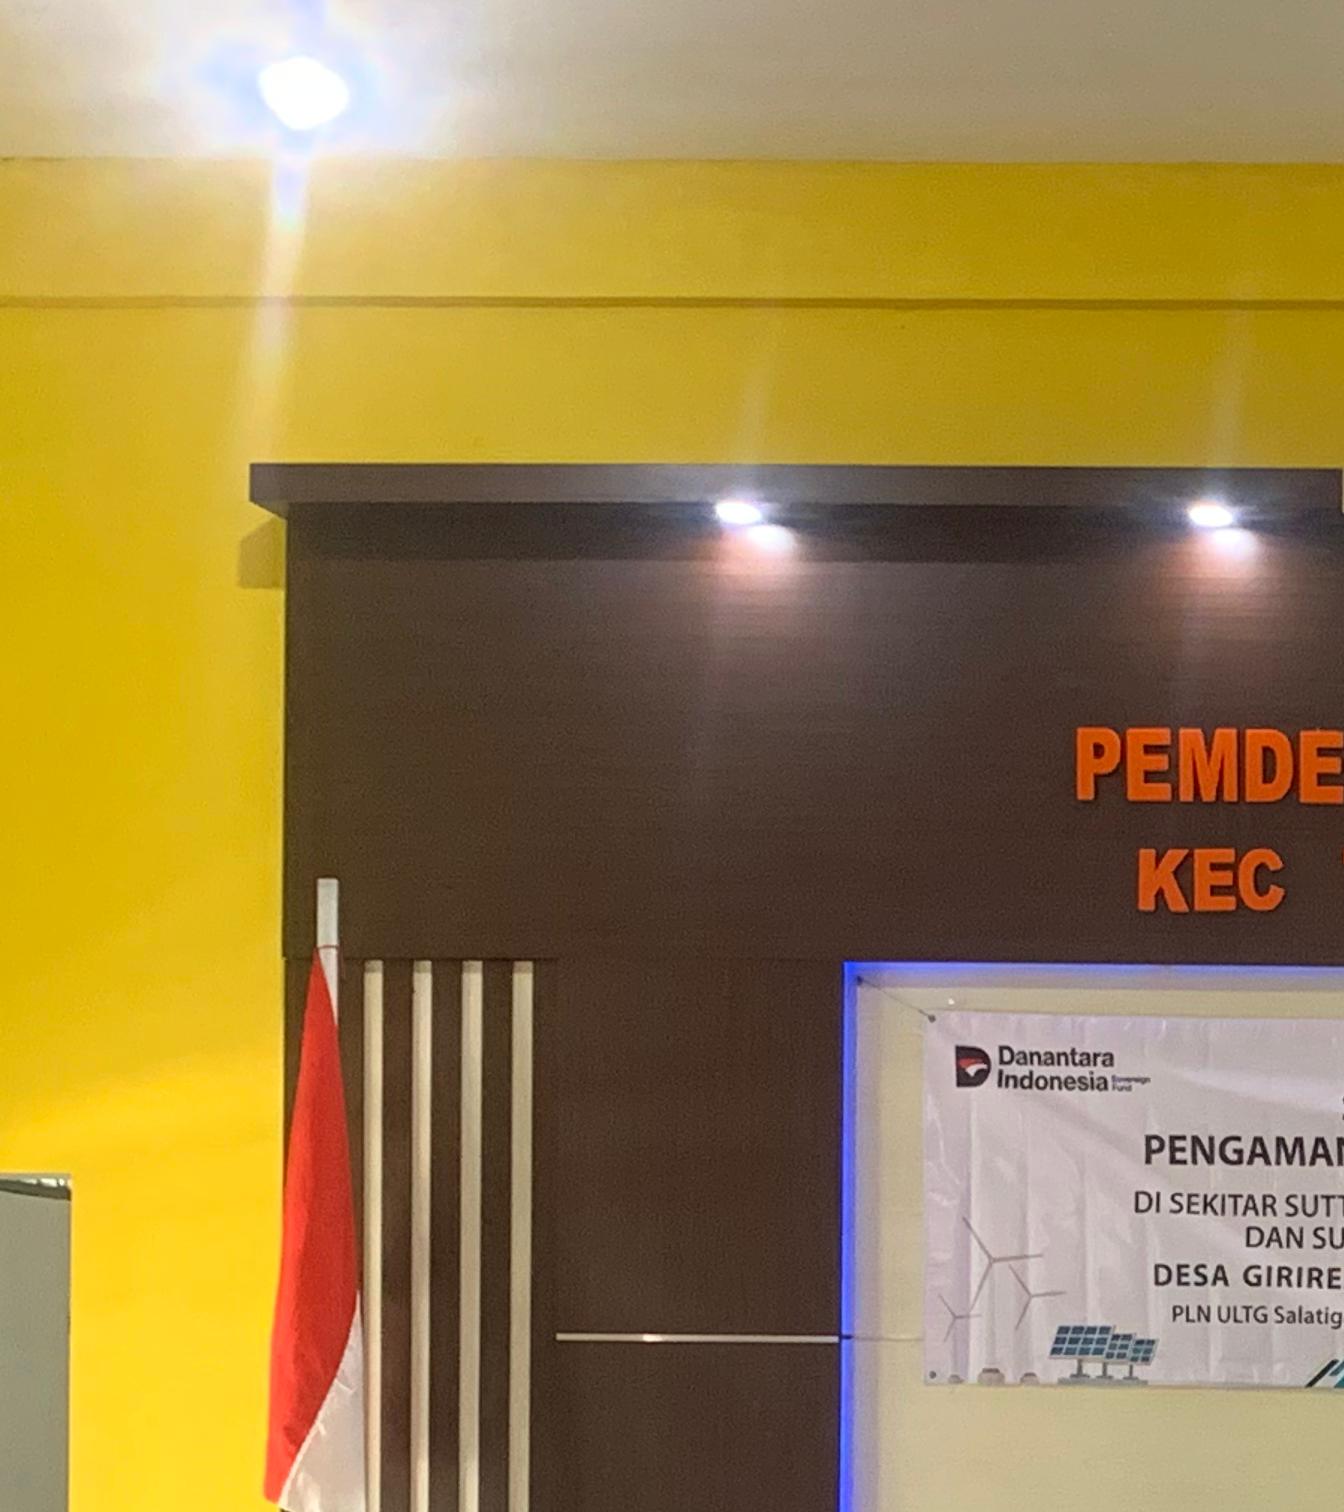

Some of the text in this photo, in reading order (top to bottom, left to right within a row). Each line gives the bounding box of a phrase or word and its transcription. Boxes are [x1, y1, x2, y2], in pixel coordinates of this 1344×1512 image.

[1138, 848, 1286, 913] KEC
[998, 1045, 1115, 1068] Danantara
[997, 1069, 1109, 1092] Indonesia
[1134, 1191, 1161, 1213] DI
[1169, 1192, 1277, 1217] SEKITAR
[1246, 1227, 1304, 1249] DAN
[1154, 1264, 1229, 1287] DESA
[1172, 1306, 1211, 1323] PLN
[1217, 1306, 1268, 1324] ULTG
